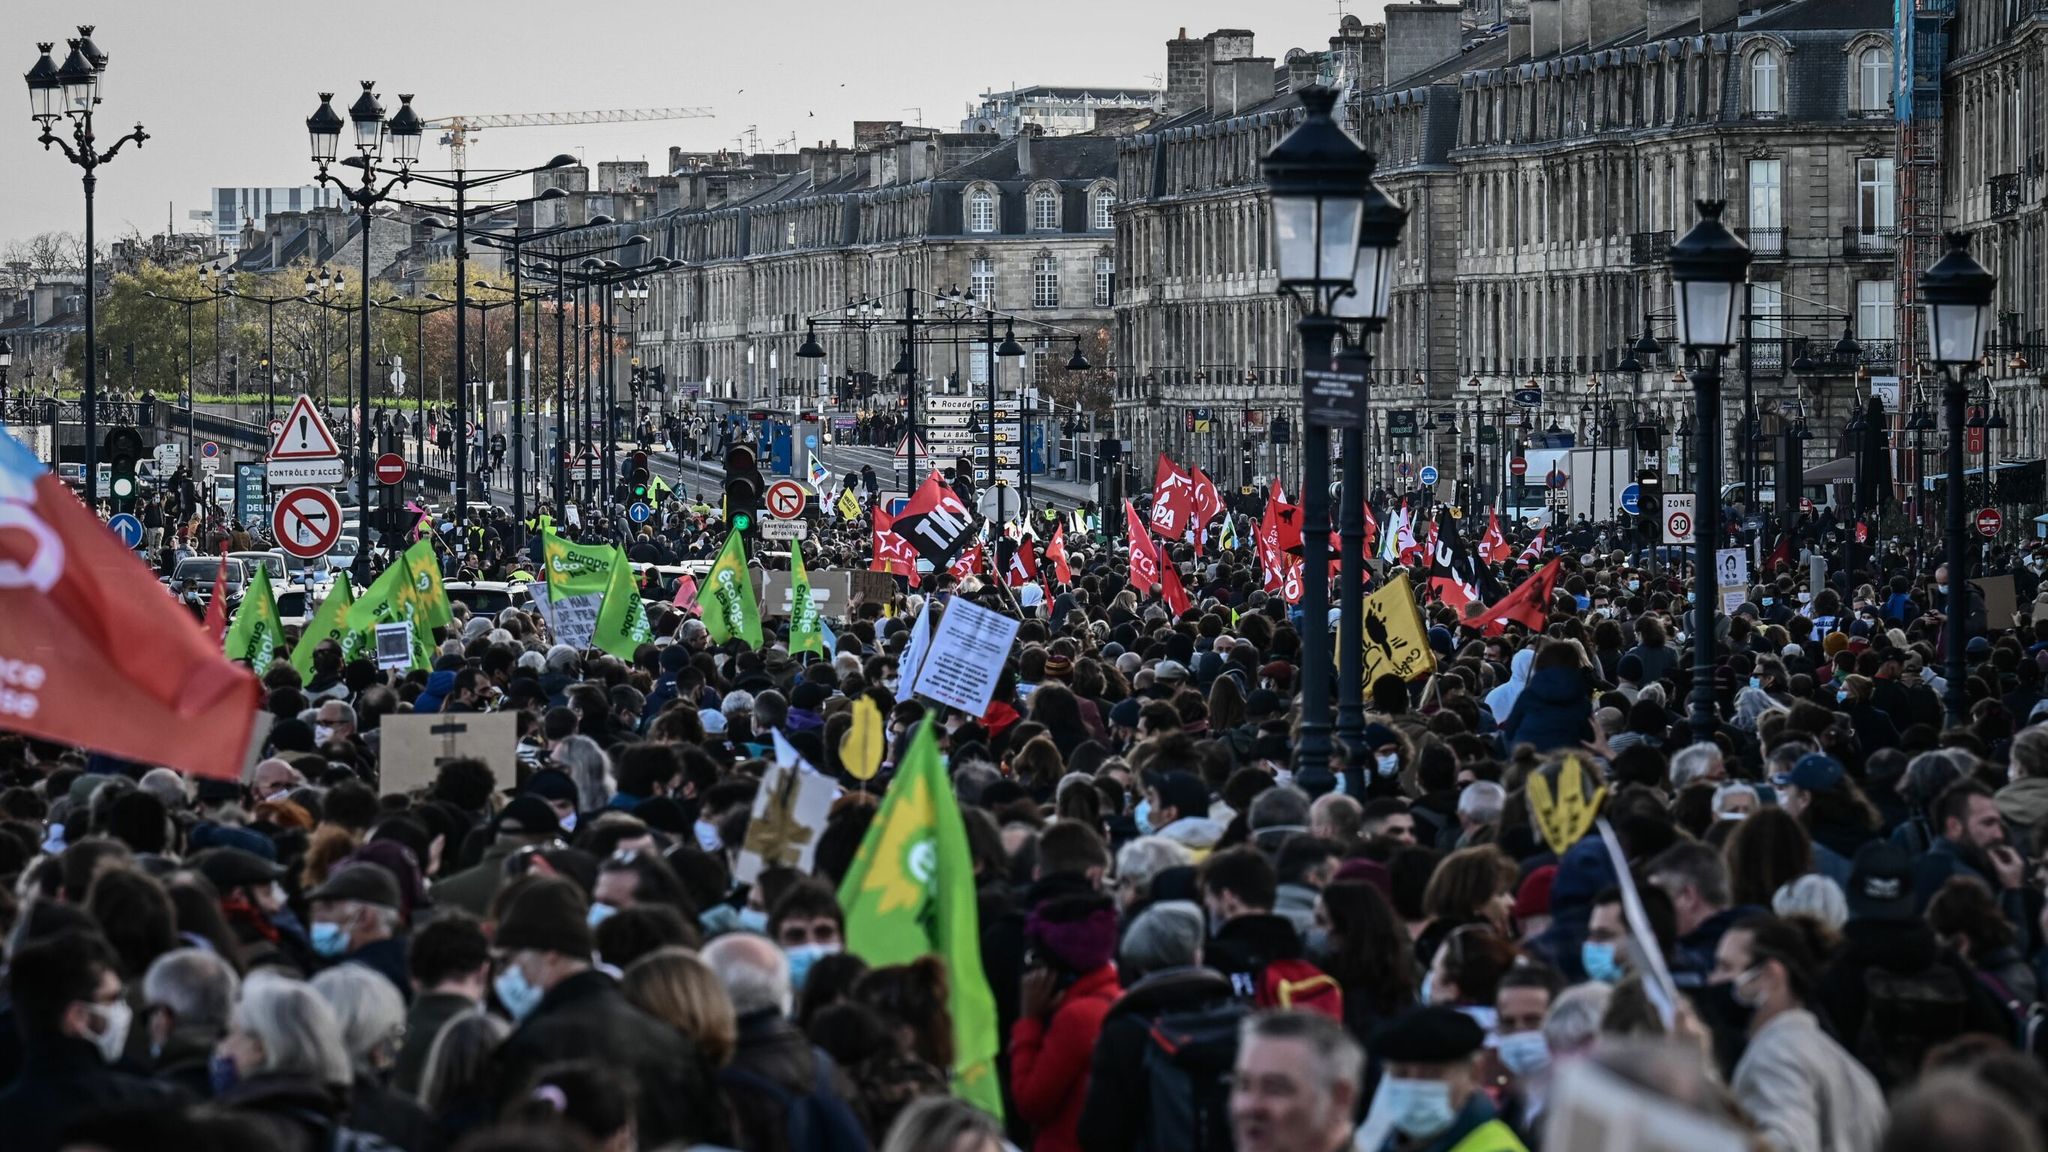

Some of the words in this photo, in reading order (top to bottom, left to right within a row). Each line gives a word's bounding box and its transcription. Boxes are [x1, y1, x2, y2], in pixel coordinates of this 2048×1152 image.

[270, 468, 308, 477] CONTRÔLE
[1673, 520, 1686, 530] 30
[567, 550, 609, 570] europe
